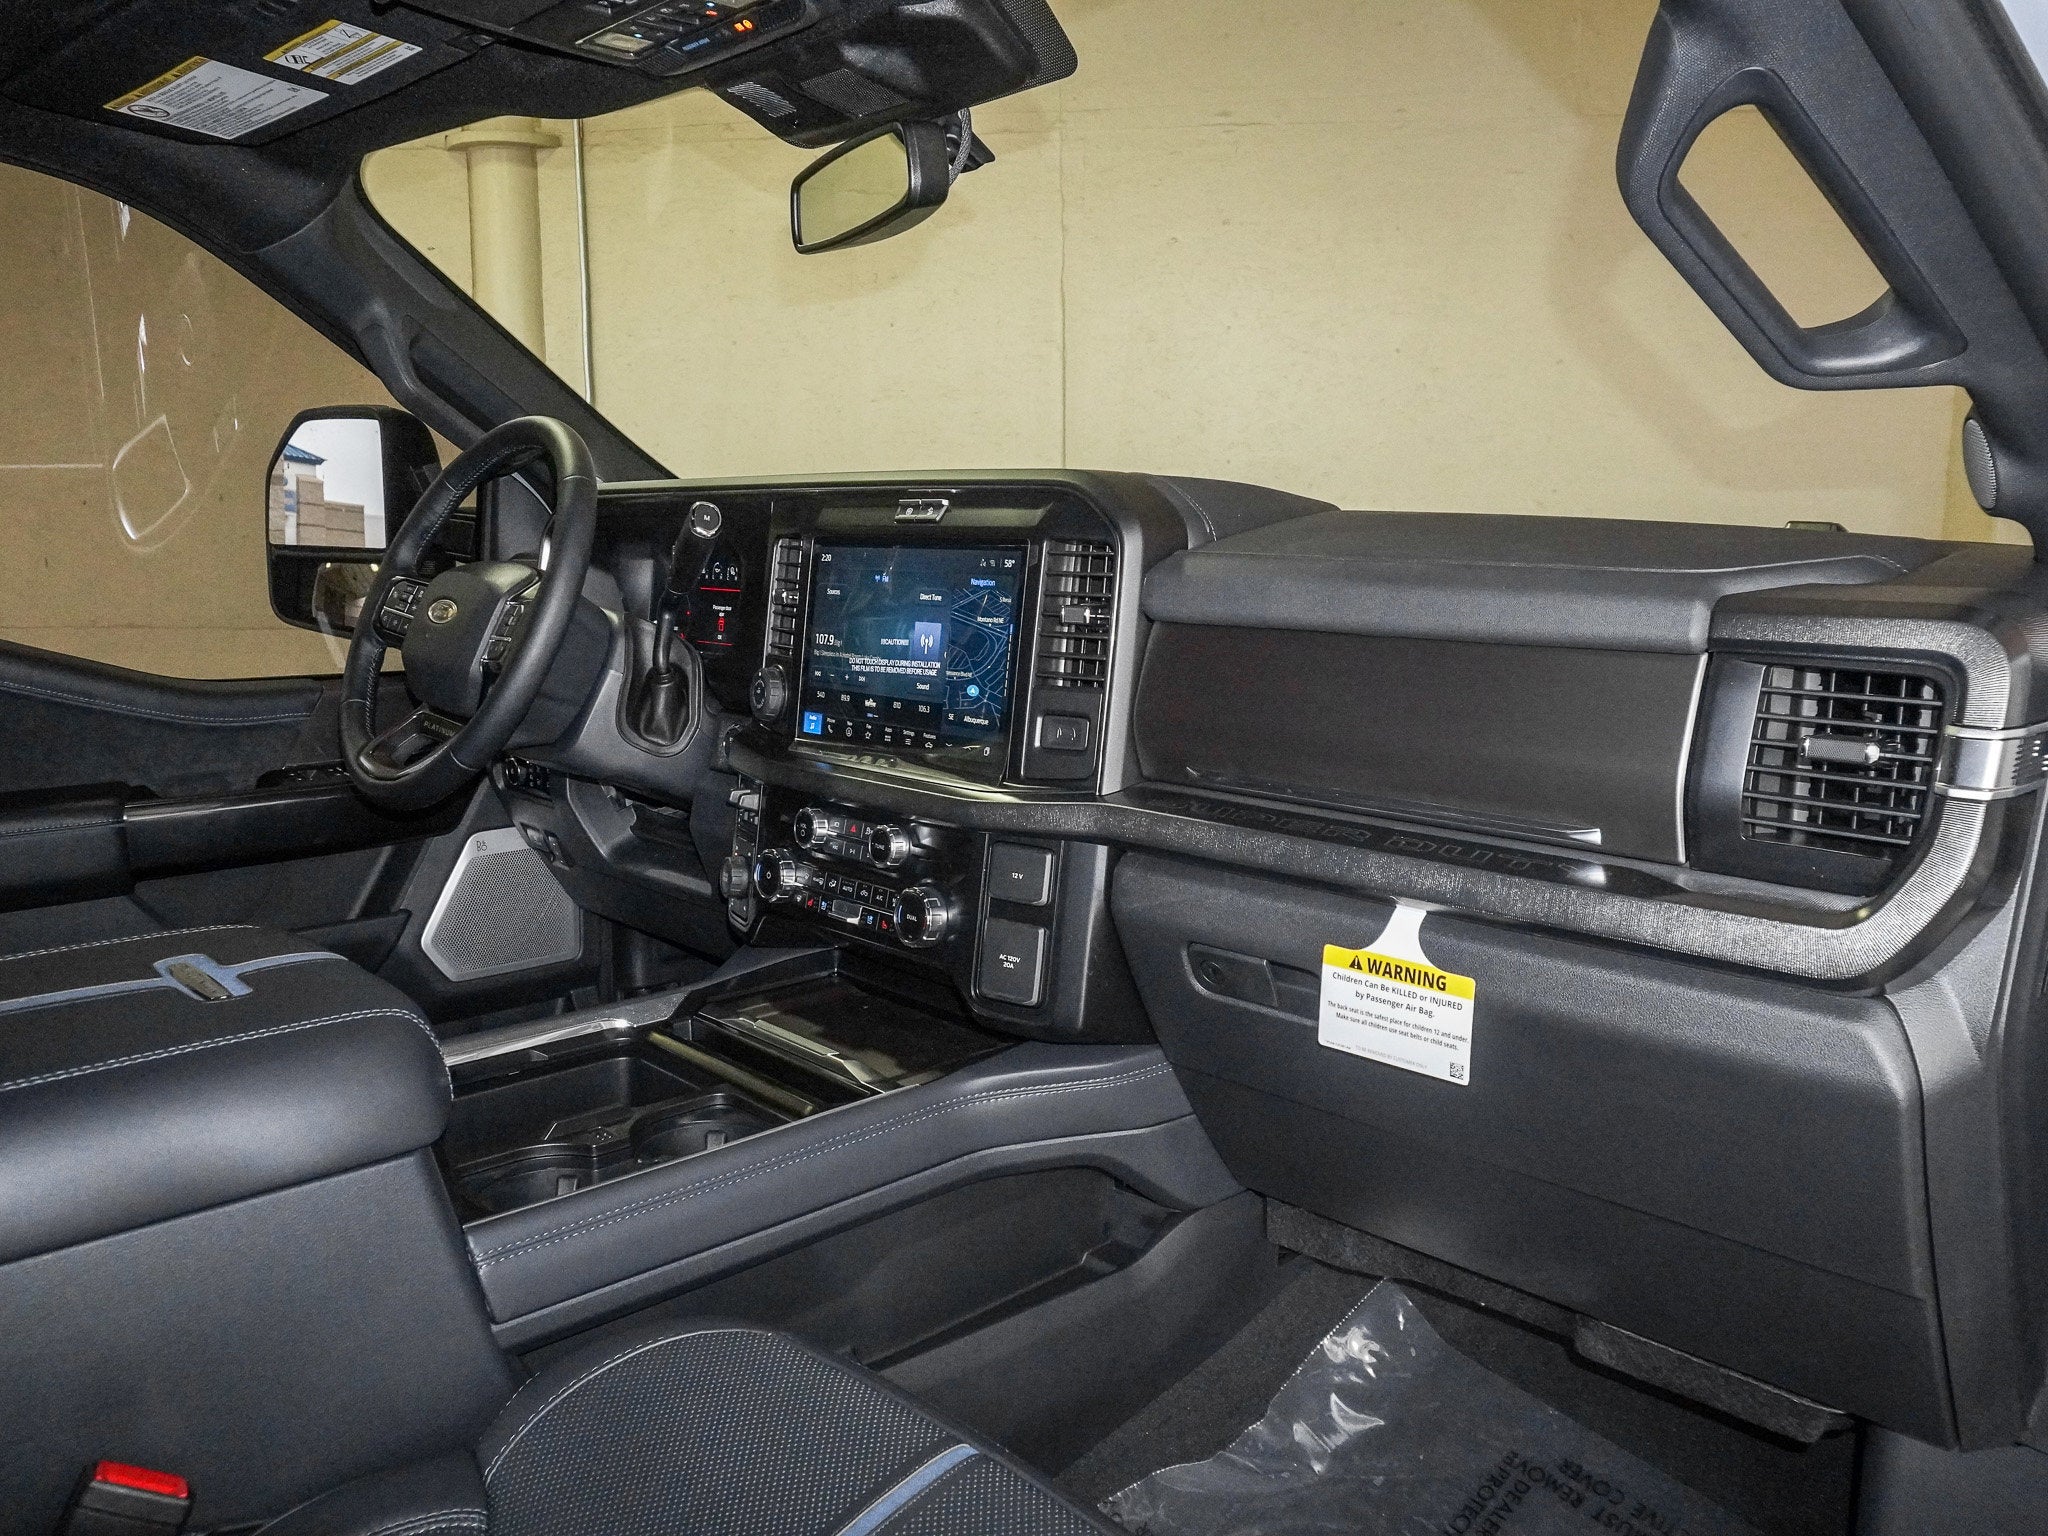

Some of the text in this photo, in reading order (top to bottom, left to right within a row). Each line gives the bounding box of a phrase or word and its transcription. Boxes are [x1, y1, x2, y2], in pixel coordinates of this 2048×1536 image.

[703, 514, 711, 522] M
[970, 577, 996, 587] Navigation
[815, 633, 835, 646] 107.9
[851, 664, 861, 672] THIS
[879, 658, 895, 666] DISPLAY
[895, 659, 911, 668] DURING
[911, 660, 941, 669] INSTALLATION
[916, 682, 930, 691] Sound
[963, 715, 989, 725] Albuquerque
[906, 913, 918, 922] DUAL
[999, 953, 1007, 961] AC
[1003, 961, 1014, 969] 20A
[1367, 957, 1447, 991] WARNING
[1332, 972, 1363, 985] Children
[1364, 980, 1379, 990] Can
[1380, 984, 1390, 992] Be
[1391, 987, 1418, 999] KILLED
[1429, 996, 1463, 1011] INJURED
[1355, 990, 1435, 1018] by Passenger Air Bag.
[1337, 1002, 1348, 1011] back
[1349, 1006, 1359, 1014] seat
[1365, 1010, 1373, 1018] the
[1374, 1013, 1389, 1022] safest
[1389, 1017, 1402, 1026] place
[1403, 1020, 1411, 1028] for
[1411, 1023, 1433, 1034] children
[1433, 1028, 1440, 1036] 12
[1440, 1031, 1451, 1039] and
[1336, 1012, 1349, 1021] Make
[1368, 1020, 1388, 1032] children
[1398, 1029, 1410, 1037] seat
[1410, 1032, 1423, 1041] belts
[1430, 1037, 1443, 1047] child
[1558, 1458, 1625, 1506] COVER
[1443, 1466, 1512, 1536] PROTEC
